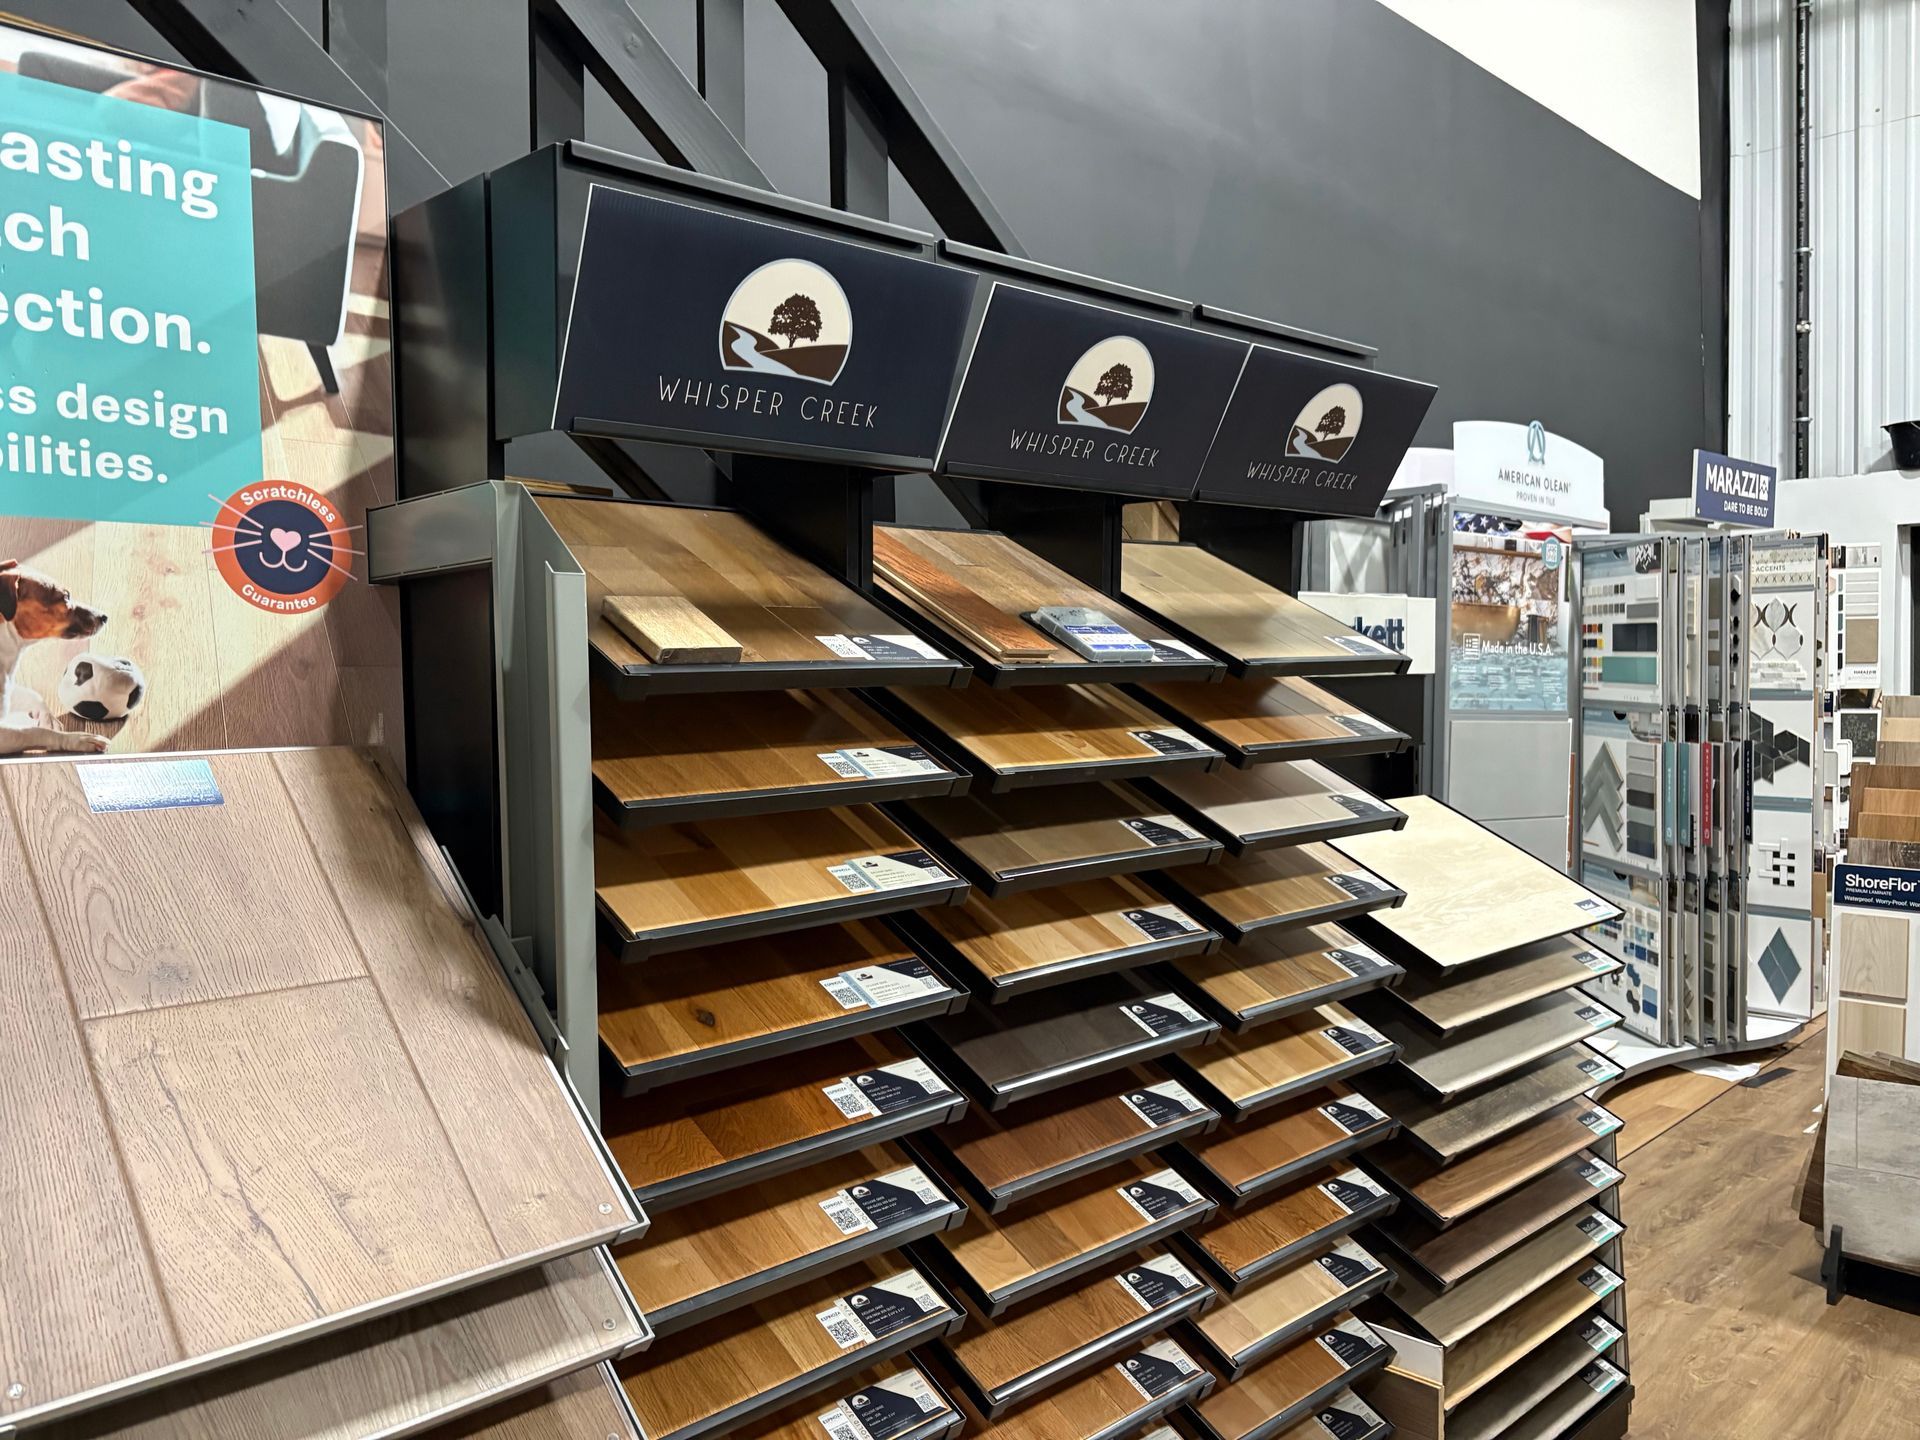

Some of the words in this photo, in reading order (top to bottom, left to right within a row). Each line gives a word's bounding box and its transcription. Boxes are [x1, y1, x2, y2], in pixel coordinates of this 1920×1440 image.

[0, 131, 219, 220] asting
[0, 204, 90, 262] ch
[0, 286, 212, 355] ection.
[0, 384, 37, 416] s
[56, 382, 229, 440] design
[657, 375, 782, 417] WHISPER
[801, 395, 880, 430] CREEK
[0, 432, 168, 485] ilities.
[1009, 429, 1095, 461] WHISPER
[1105, 440, 1160, 469] CREEK
[1246, 462, 1311, 486] WHISPER
[1315, 470, 1359, 492] CREEK
[1498, 468, 1541, 489] AMERICAN
[1705, 463, 1759, 500] MARAZZI
[240, 485, 336, 524] Scratchless
[1516, 491, 1538, 503] PROVEN
[1539, 494, 1545, 504] IN
[1545, 495, 1556, 506] TILE
[1723, 500, 1738, 512] DARE
[1739, 503, 1746, 514] TO
[1746, 505, 1754, 515] BE
[1755, 564, 1786, 573] ACCENTS
[241, 583, 318, 611] Guarantee
[1352, 616, 1405, 651] kett
[1481, 640, 1504, 655] Made
[1505, 641, 1513, 655] in
[1514, 642, 1528, 655] the
[1529, 642, 1554, 657] U.S.A.
[1845, 873, 1917, 893] ShoreFlor
[1845, 887, 1868, 895] PREMIUM
[1868, 889, 1893, 897] LAMINATE
[1844, 895, 1875, 903] Waterproof.
[1875, 898, 1908, 906] Worry-Proof.
[820, 1311, 841, 1322] ESPINOZA
[823, 1413, 843, 1425] ESPINOZA
